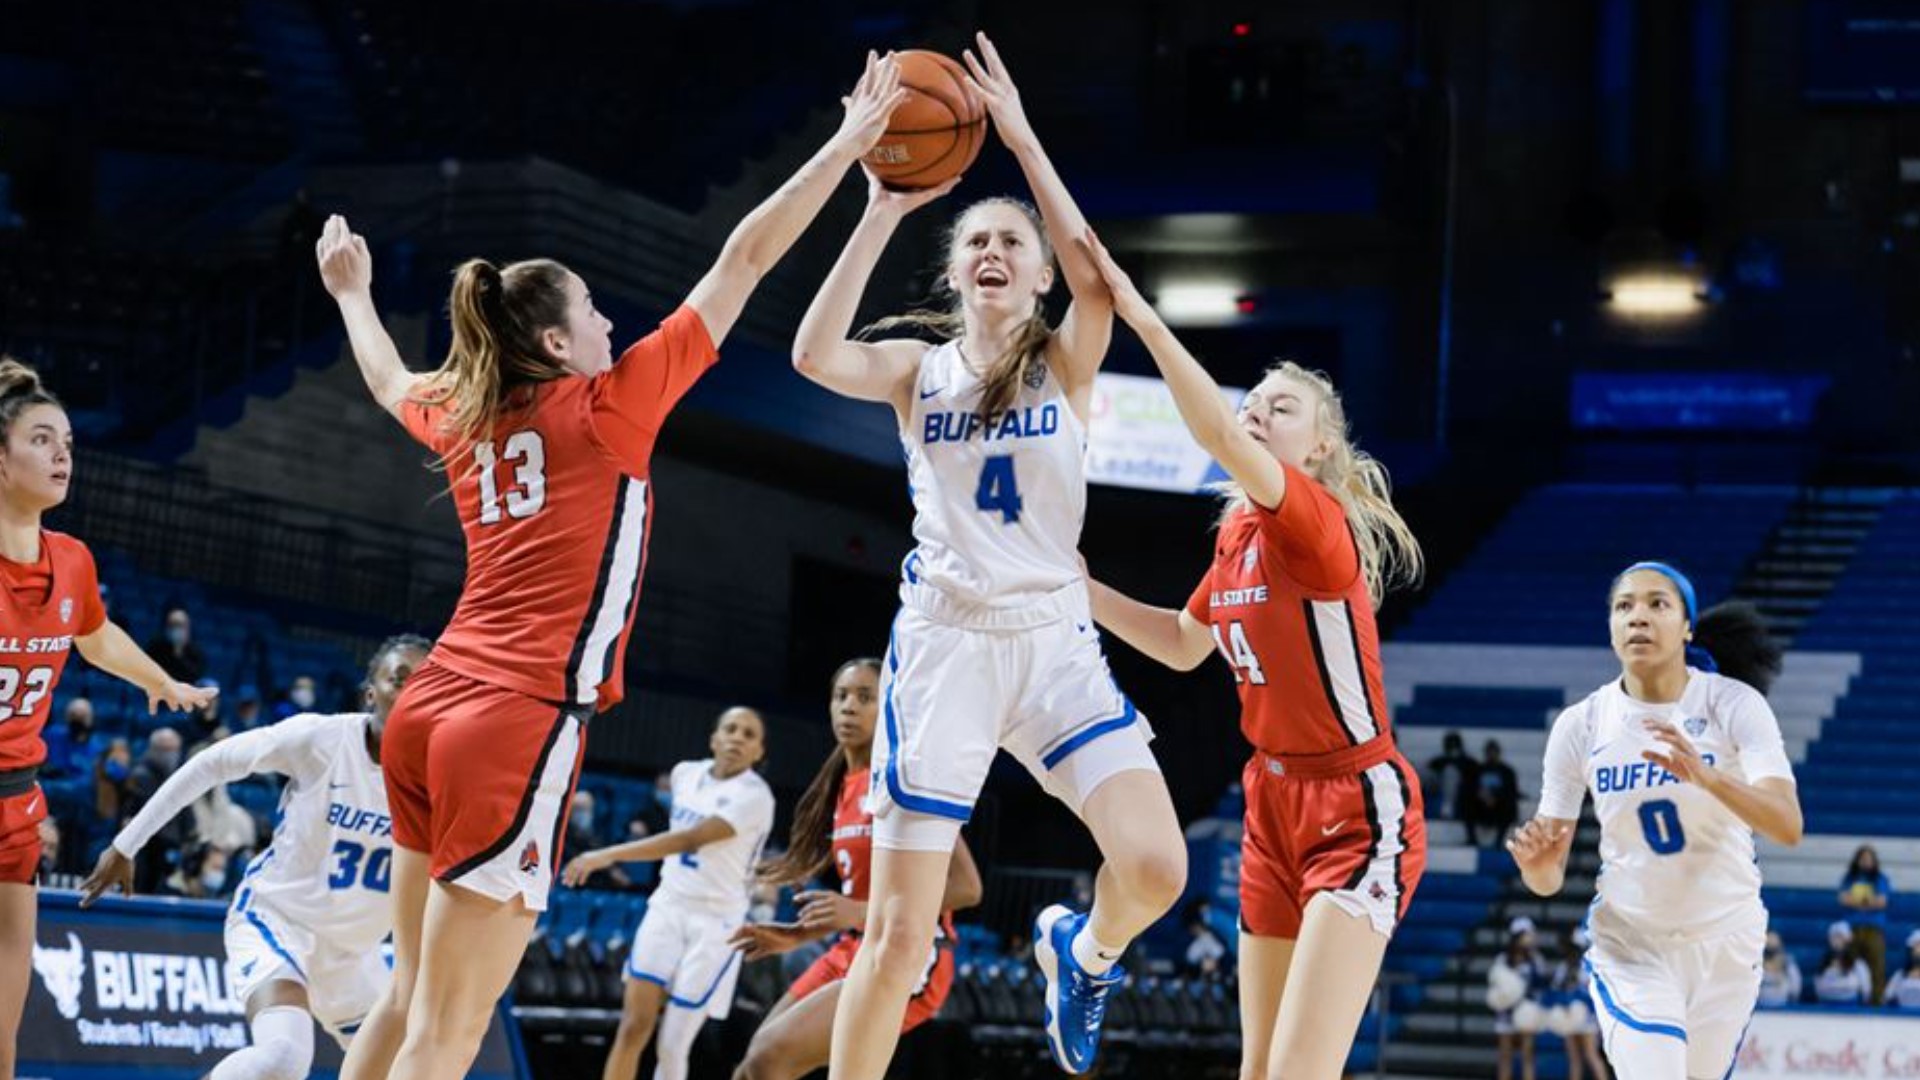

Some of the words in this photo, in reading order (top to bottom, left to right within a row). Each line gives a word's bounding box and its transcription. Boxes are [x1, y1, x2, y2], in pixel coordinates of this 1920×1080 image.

[924, 404, 1057, 443] BUFFALO
[474, 429, 546, 524] 13
[975, 455, 1022, 523] 4
[1224, 585, 1268, 605] STATE
[0, 666, 53, 721] 22
[1638, 798, 1687, 855] 0
[328, 839, 393, 894] 30
